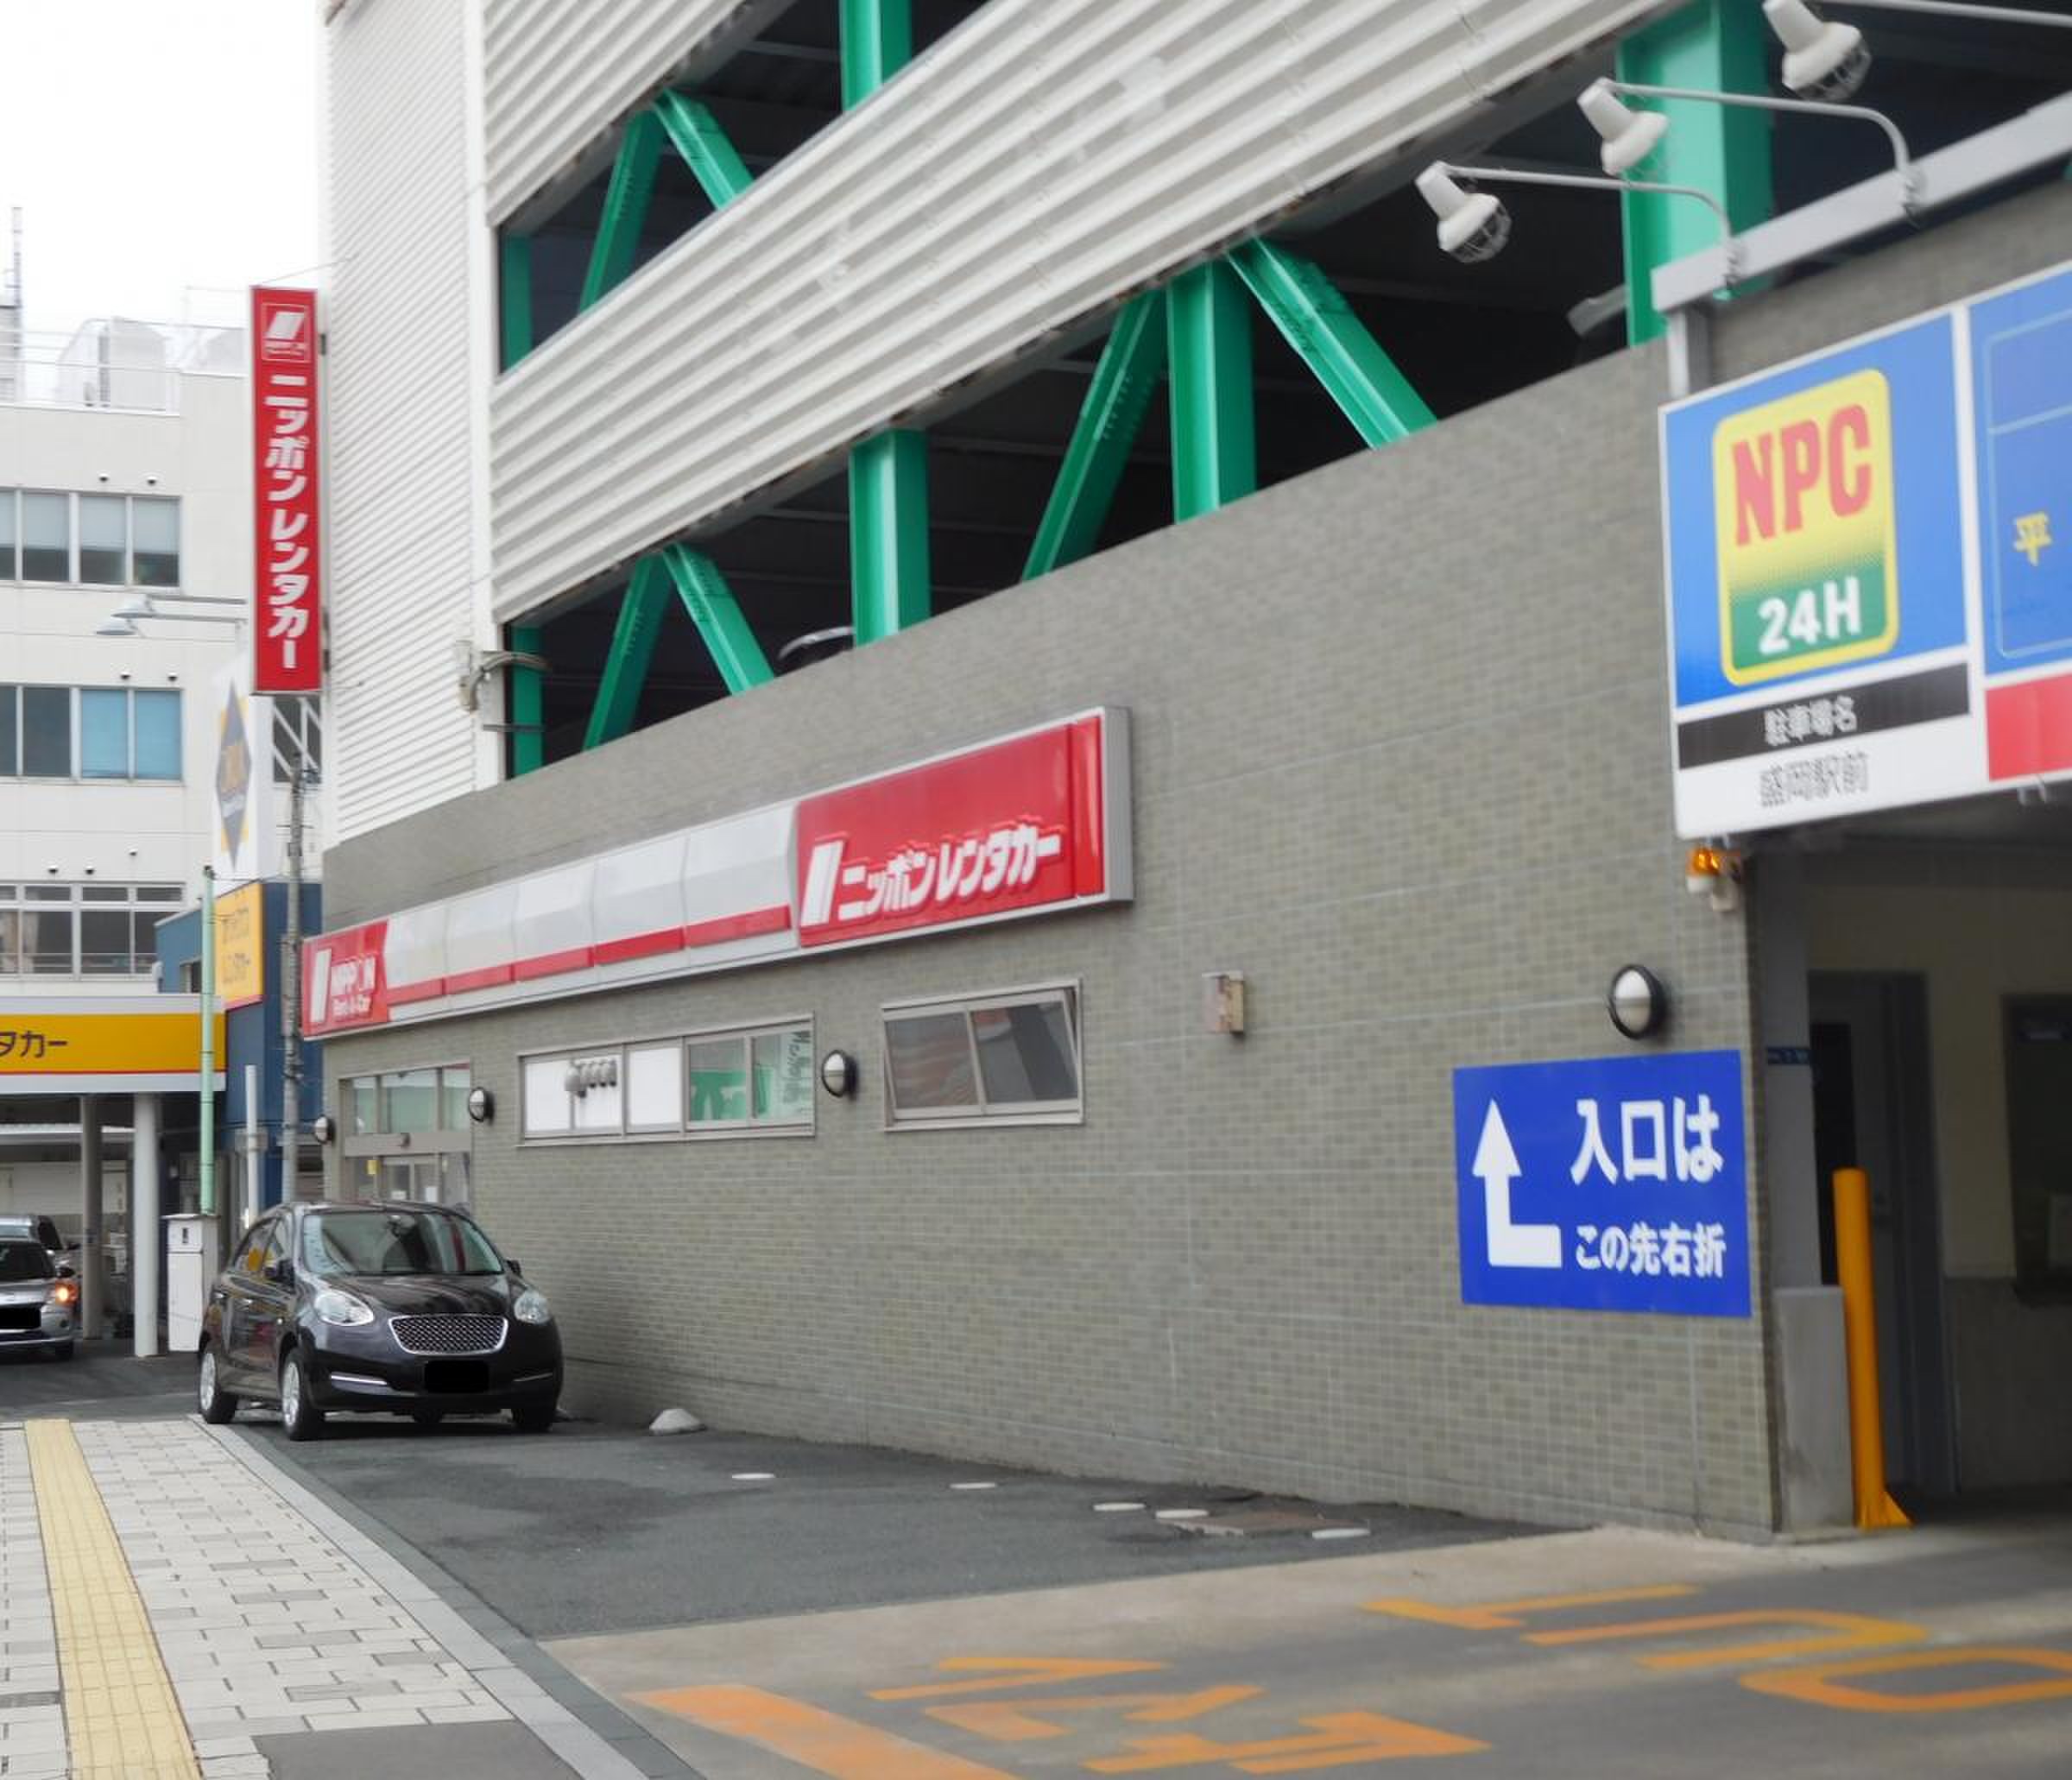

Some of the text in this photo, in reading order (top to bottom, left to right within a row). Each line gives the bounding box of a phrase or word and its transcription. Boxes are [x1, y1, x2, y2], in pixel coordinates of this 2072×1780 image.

[265, 375, 308, 669] ニッポンレンタカー
[1733, 403, 1872, 546] NPC
[1759, 576, 1861, 654] 24H
[839, 822, 1062, 920] ニッポンレンタカー
[0, 1030, 67, 1057] タカー
[1570, 1093, 1724, 1185] 入口は
[1576, 1221, 1727, 1278] この先右折
[1362, 1583, 2072, 1714] OUT
